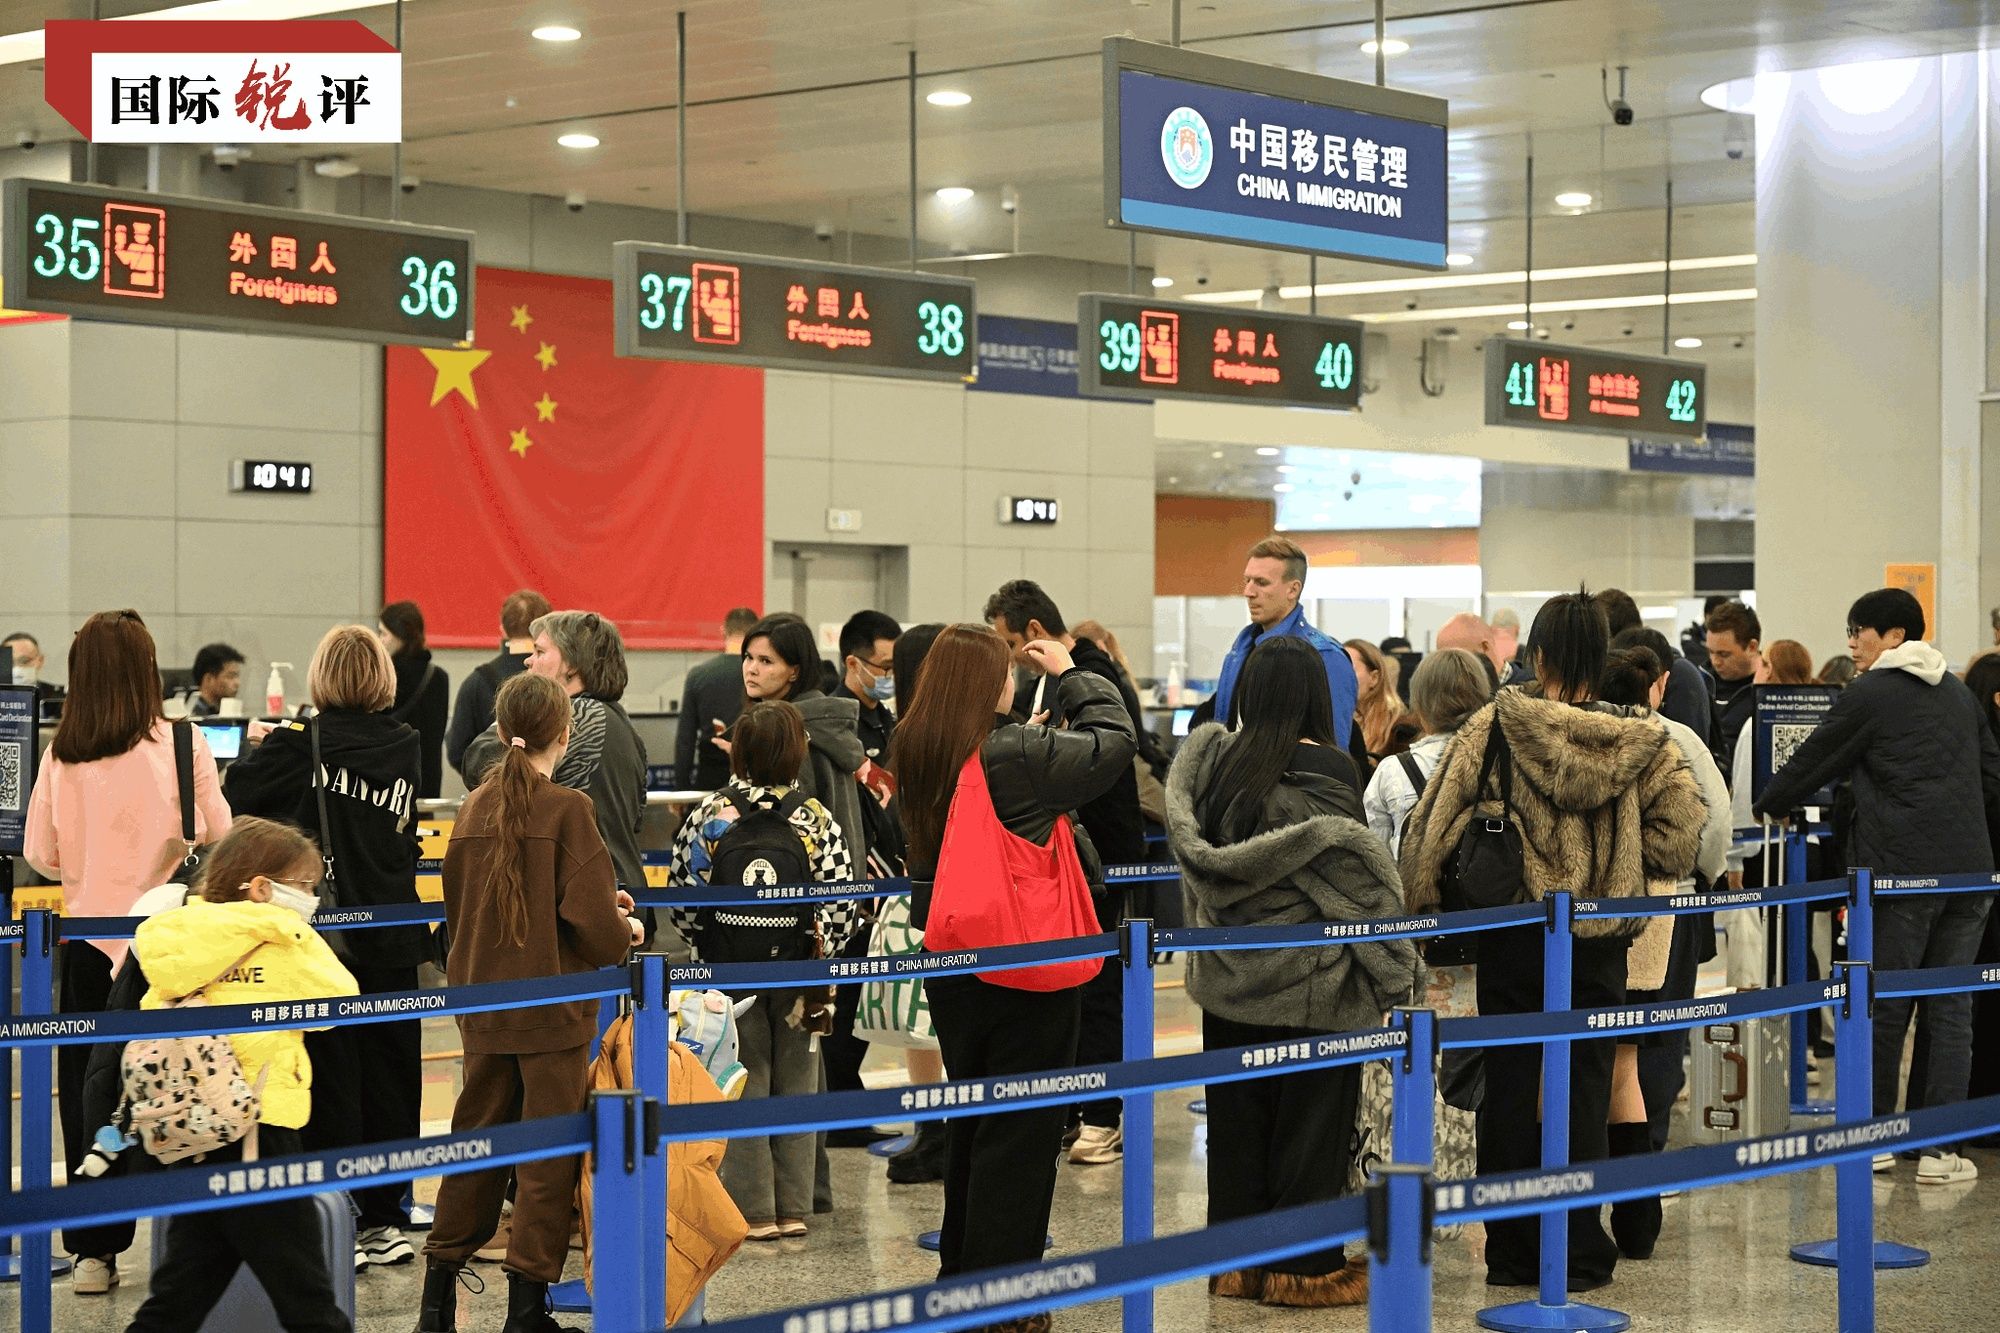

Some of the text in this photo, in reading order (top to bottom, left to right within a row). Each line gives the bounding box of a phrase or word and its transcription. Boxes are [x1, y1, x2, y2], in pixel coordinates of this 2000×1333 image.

[1229, 117, 1409, 190] 中国移民管理
[1237, 173, 1402, 219] CHINA IMMIGRATION
[33, 214, 99, 281] 35
[229, 232, 337, 275] 外国人
[229, 271, 338, 305] Foreigners
[400, 256, 458, 319] 36
[640, 272, 692, 332] 37
[786, 285, 870, 320] 外国人
[918, 301, 965, 357] 38
[1100, 320, 1141, 372] 39
[1315, 342, 1353, 390] 40
[1505, 362, 1536, 406] 41
[1665, 379, 1696, 422] 42
[809, 884, 874, 896] CHINA IMMIGRATION
[1711, 892, 1761, 905] CHINA IMMIGRATION
[318, 911, 373, 924] IMMIGRATION
[1324, 924, 1370, 937] 中国移民管理
[1374, 918, 1438, 934] CHINA IMMIGRATION
[830, 962, 890, 976] 中国移民管理
[896, 953, 978, 972] CHINA IMMGRATION
[251, 1003, 330, 1023] 中国移民管理
[338, 995, 445, 1015] CHINA IMMIGRATION
[1588, 1009, 1645, 1029] 中国移民管理
[1650, 1003, 1727, 1023] CHINA IMMIGRATION
[12, 1019, 96, 1037] IMMIGRATION
[901, 1083, 985, 1109] 中国移民管理
[993, 1072, 1106, 1099] CHINA IMMIGRATION
[336, 1138, 492, 1178] CHINA IMMIGRATION
[208, 1160, 325, 1196] 中国移民管理
